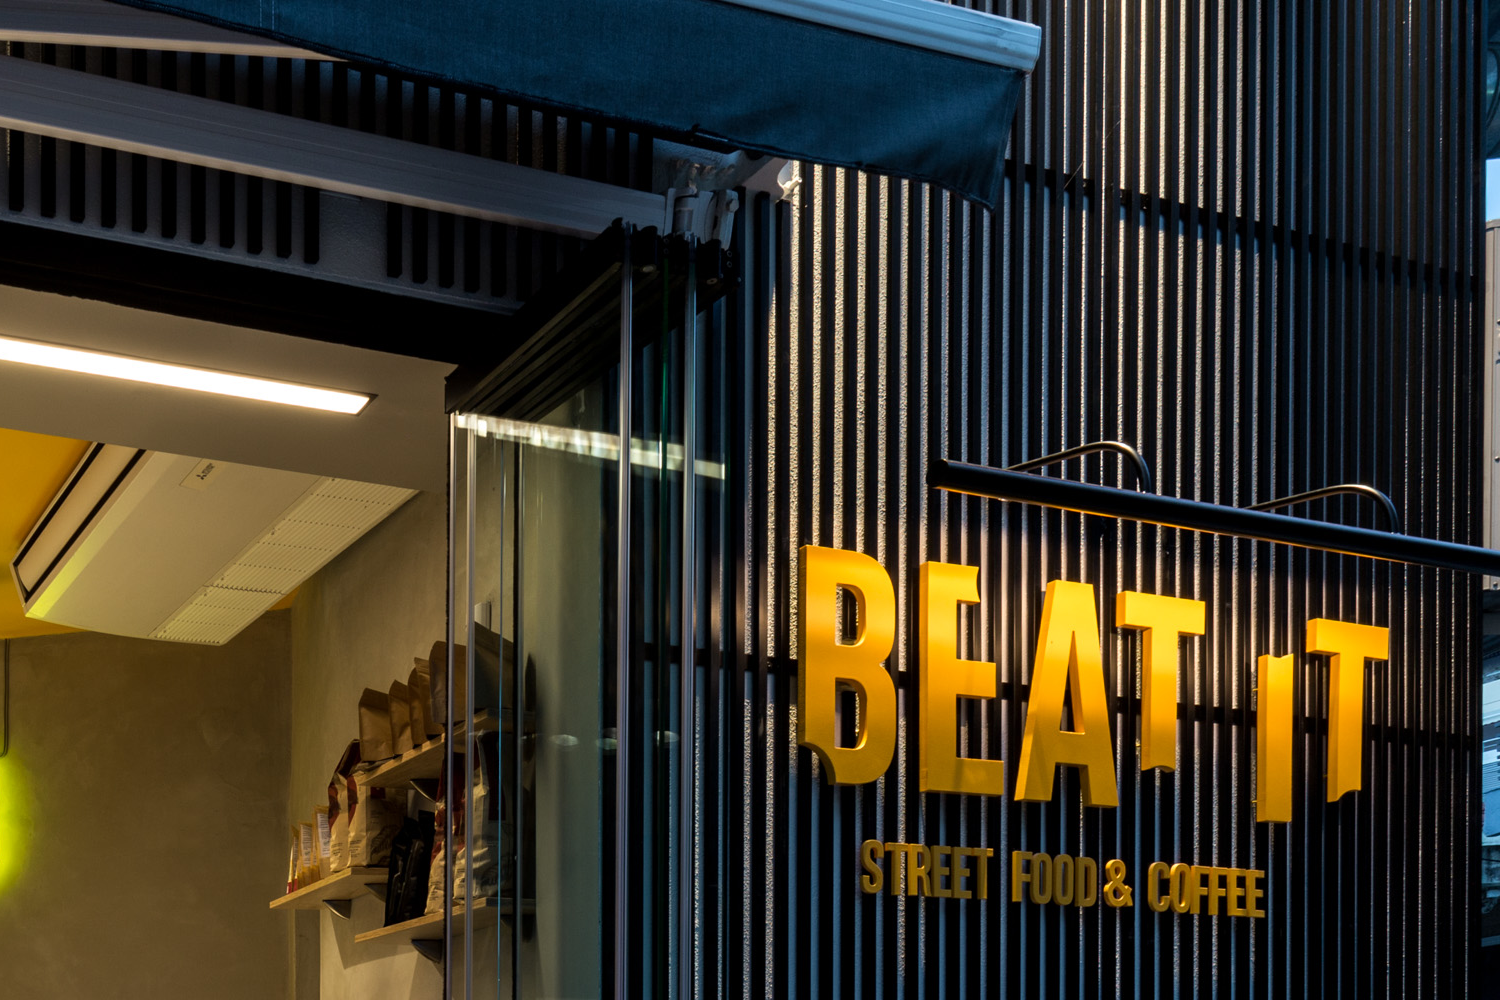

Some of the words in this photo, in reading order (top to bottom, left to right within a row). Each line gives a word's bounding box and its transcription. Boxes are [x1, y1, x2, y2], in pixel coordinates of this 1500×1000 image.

[797, 545, 1206, 807] BEAT
[1255, 616, 1390, 823] IT
[861, 839, 994, 899] STREET
[1012, 850, 1097, 907] FOOD
[1103, 858, 1133, 907] &
[1148, 861, 1265, 918] COFFEE
